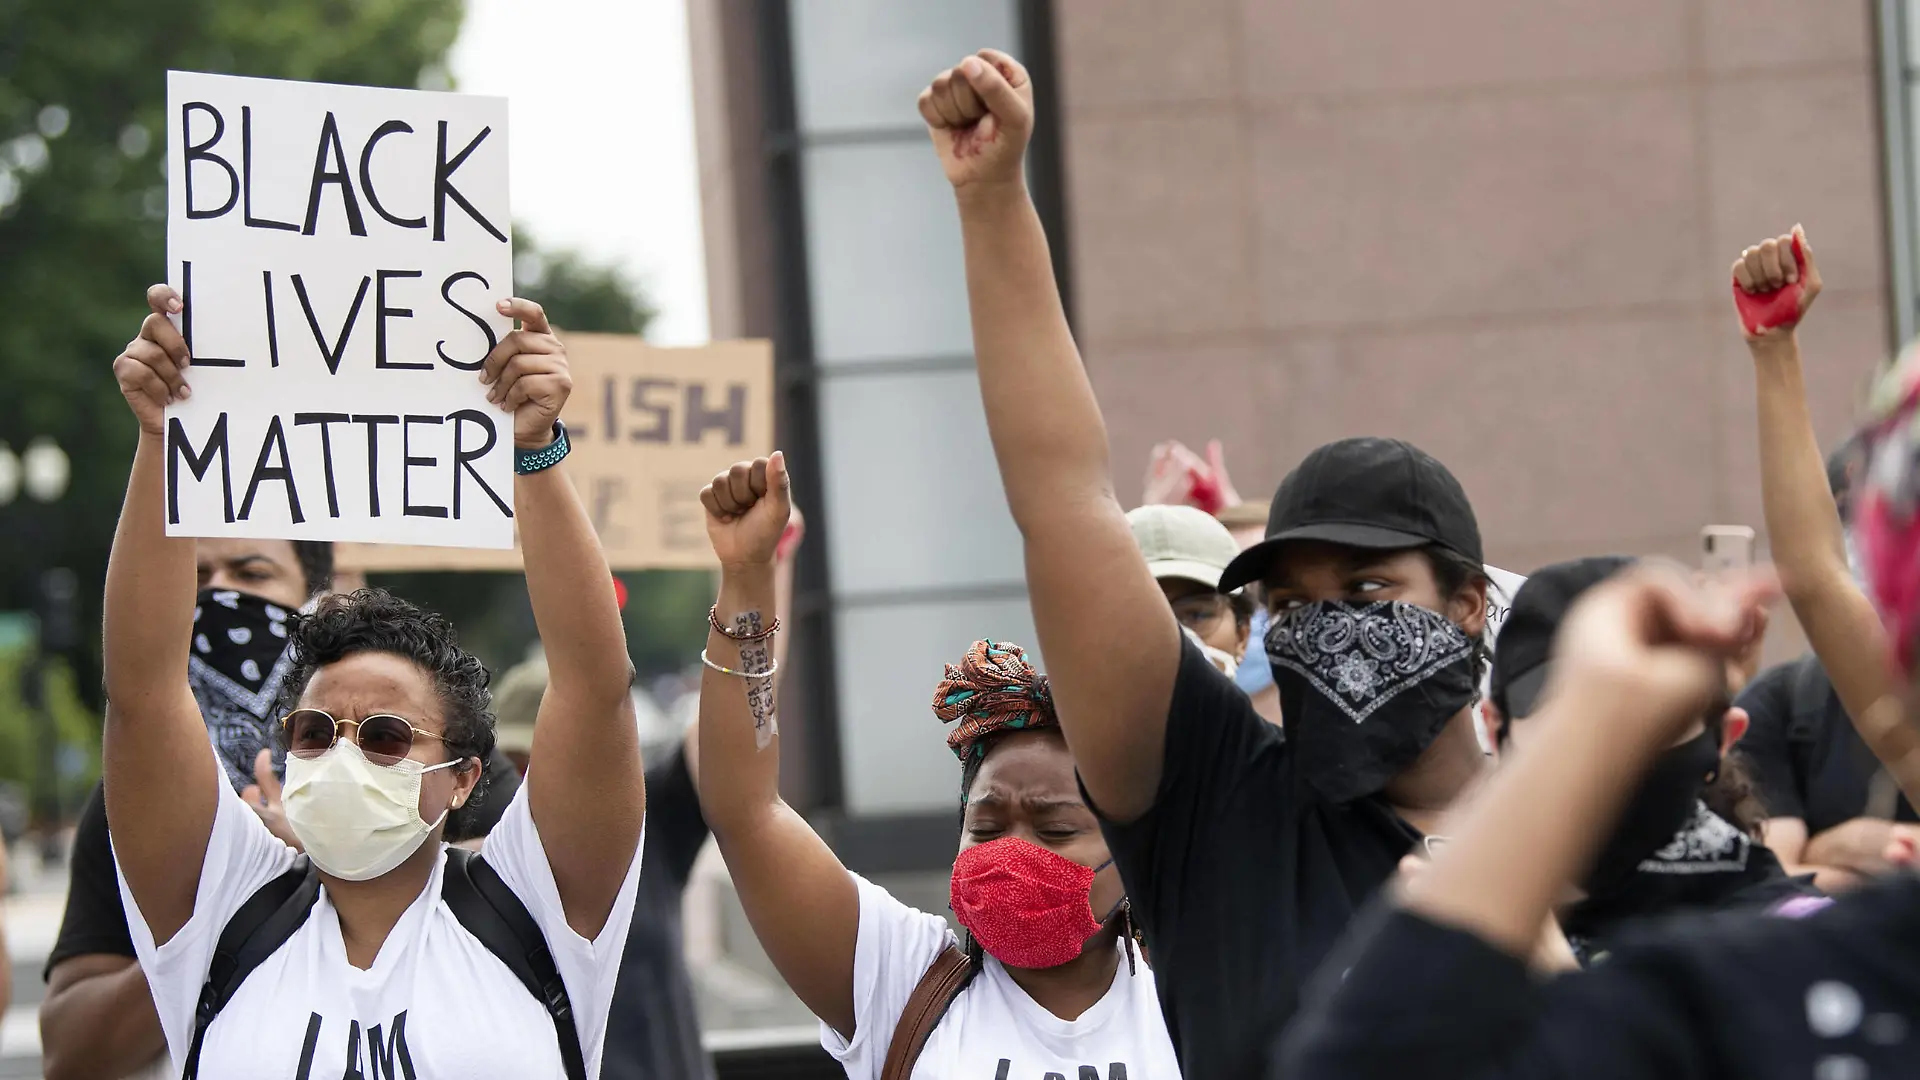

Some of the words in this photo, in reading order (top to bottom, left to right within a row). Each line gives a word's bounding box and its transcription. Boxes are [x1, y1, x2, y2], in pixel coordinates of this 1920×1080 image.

[182, 101, 508, 243] BLACK
[181, 260, 497, 376] LIVES
[167, 409, 514, 525] MATTER
[568, 376, 748, 446] ISH
[295, 1011, 323, 1080] I
[342, 1009, 417, 1080] AM
